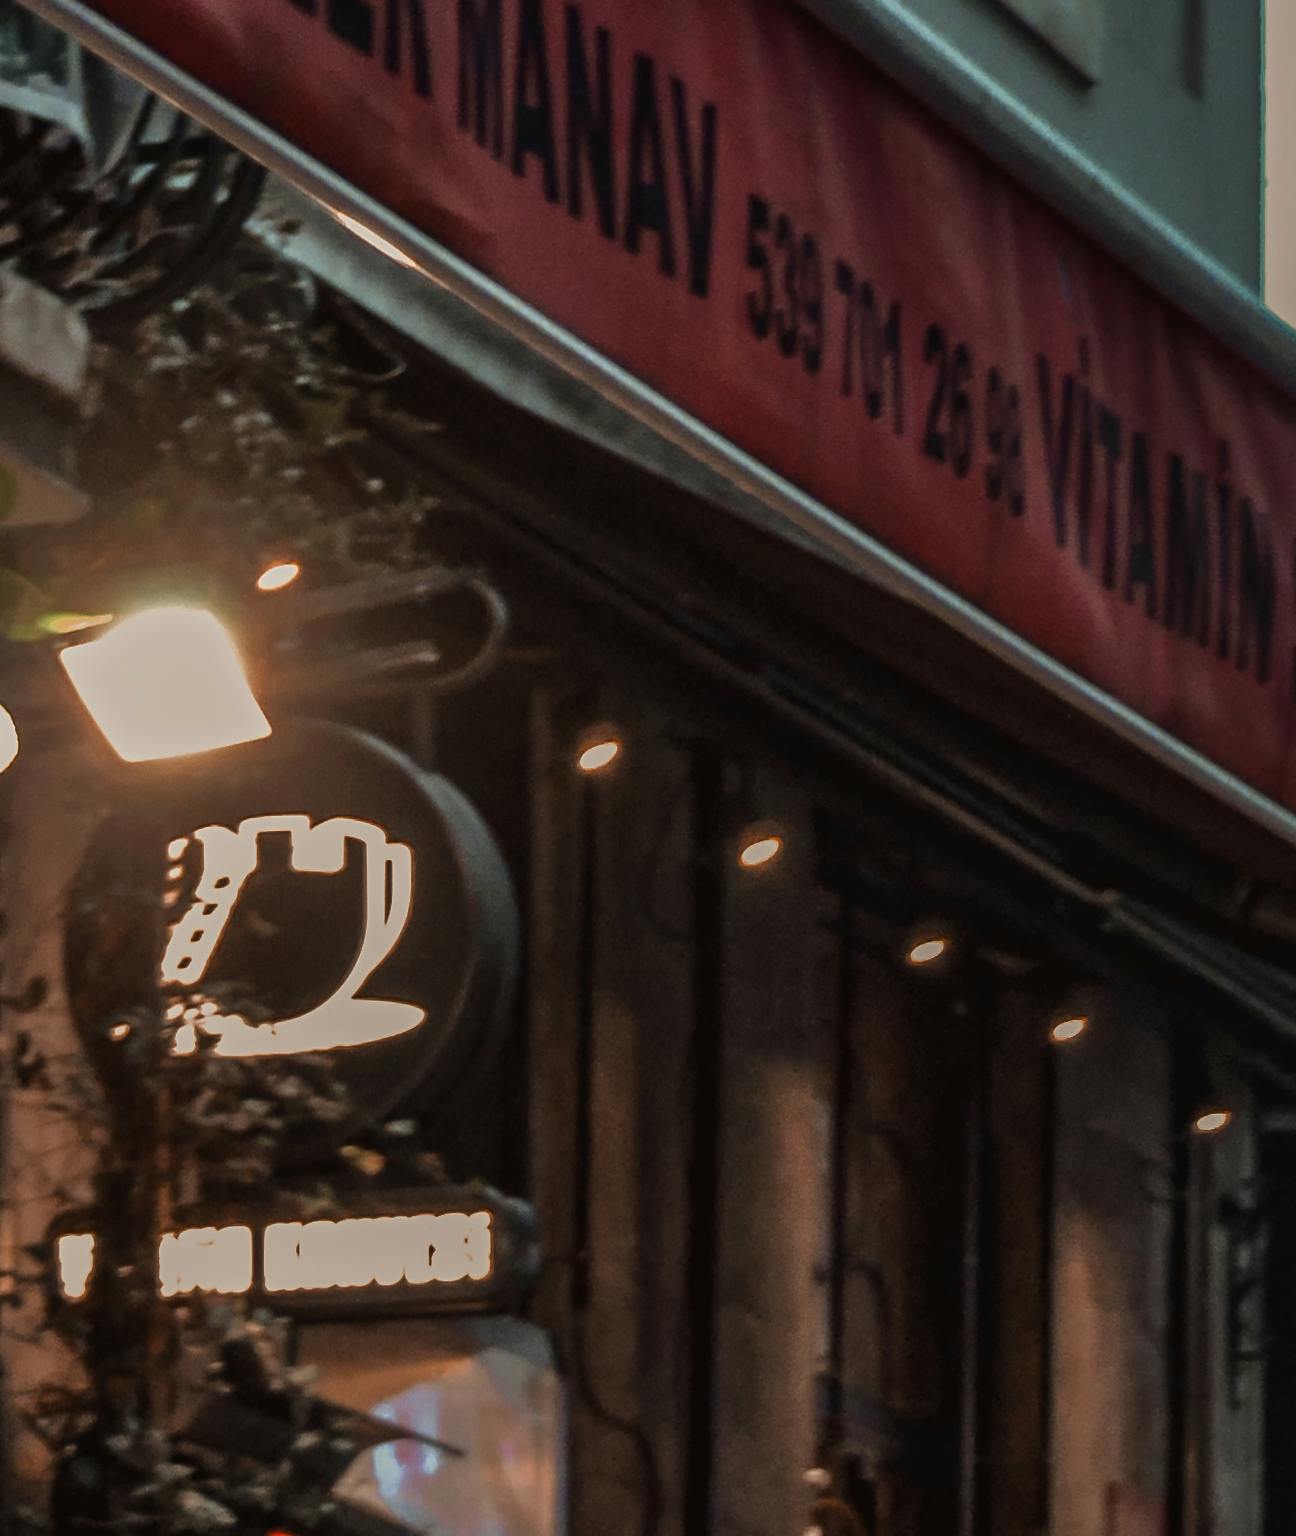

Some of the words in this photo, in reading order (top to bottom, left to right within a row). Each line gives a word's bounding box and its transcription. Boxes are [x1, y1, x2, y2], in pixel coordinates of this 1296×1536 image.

[457, 0, 717, 298] MANAV
[747, 193, 824, 374] 539
[923, 322, 975, 479] 26
